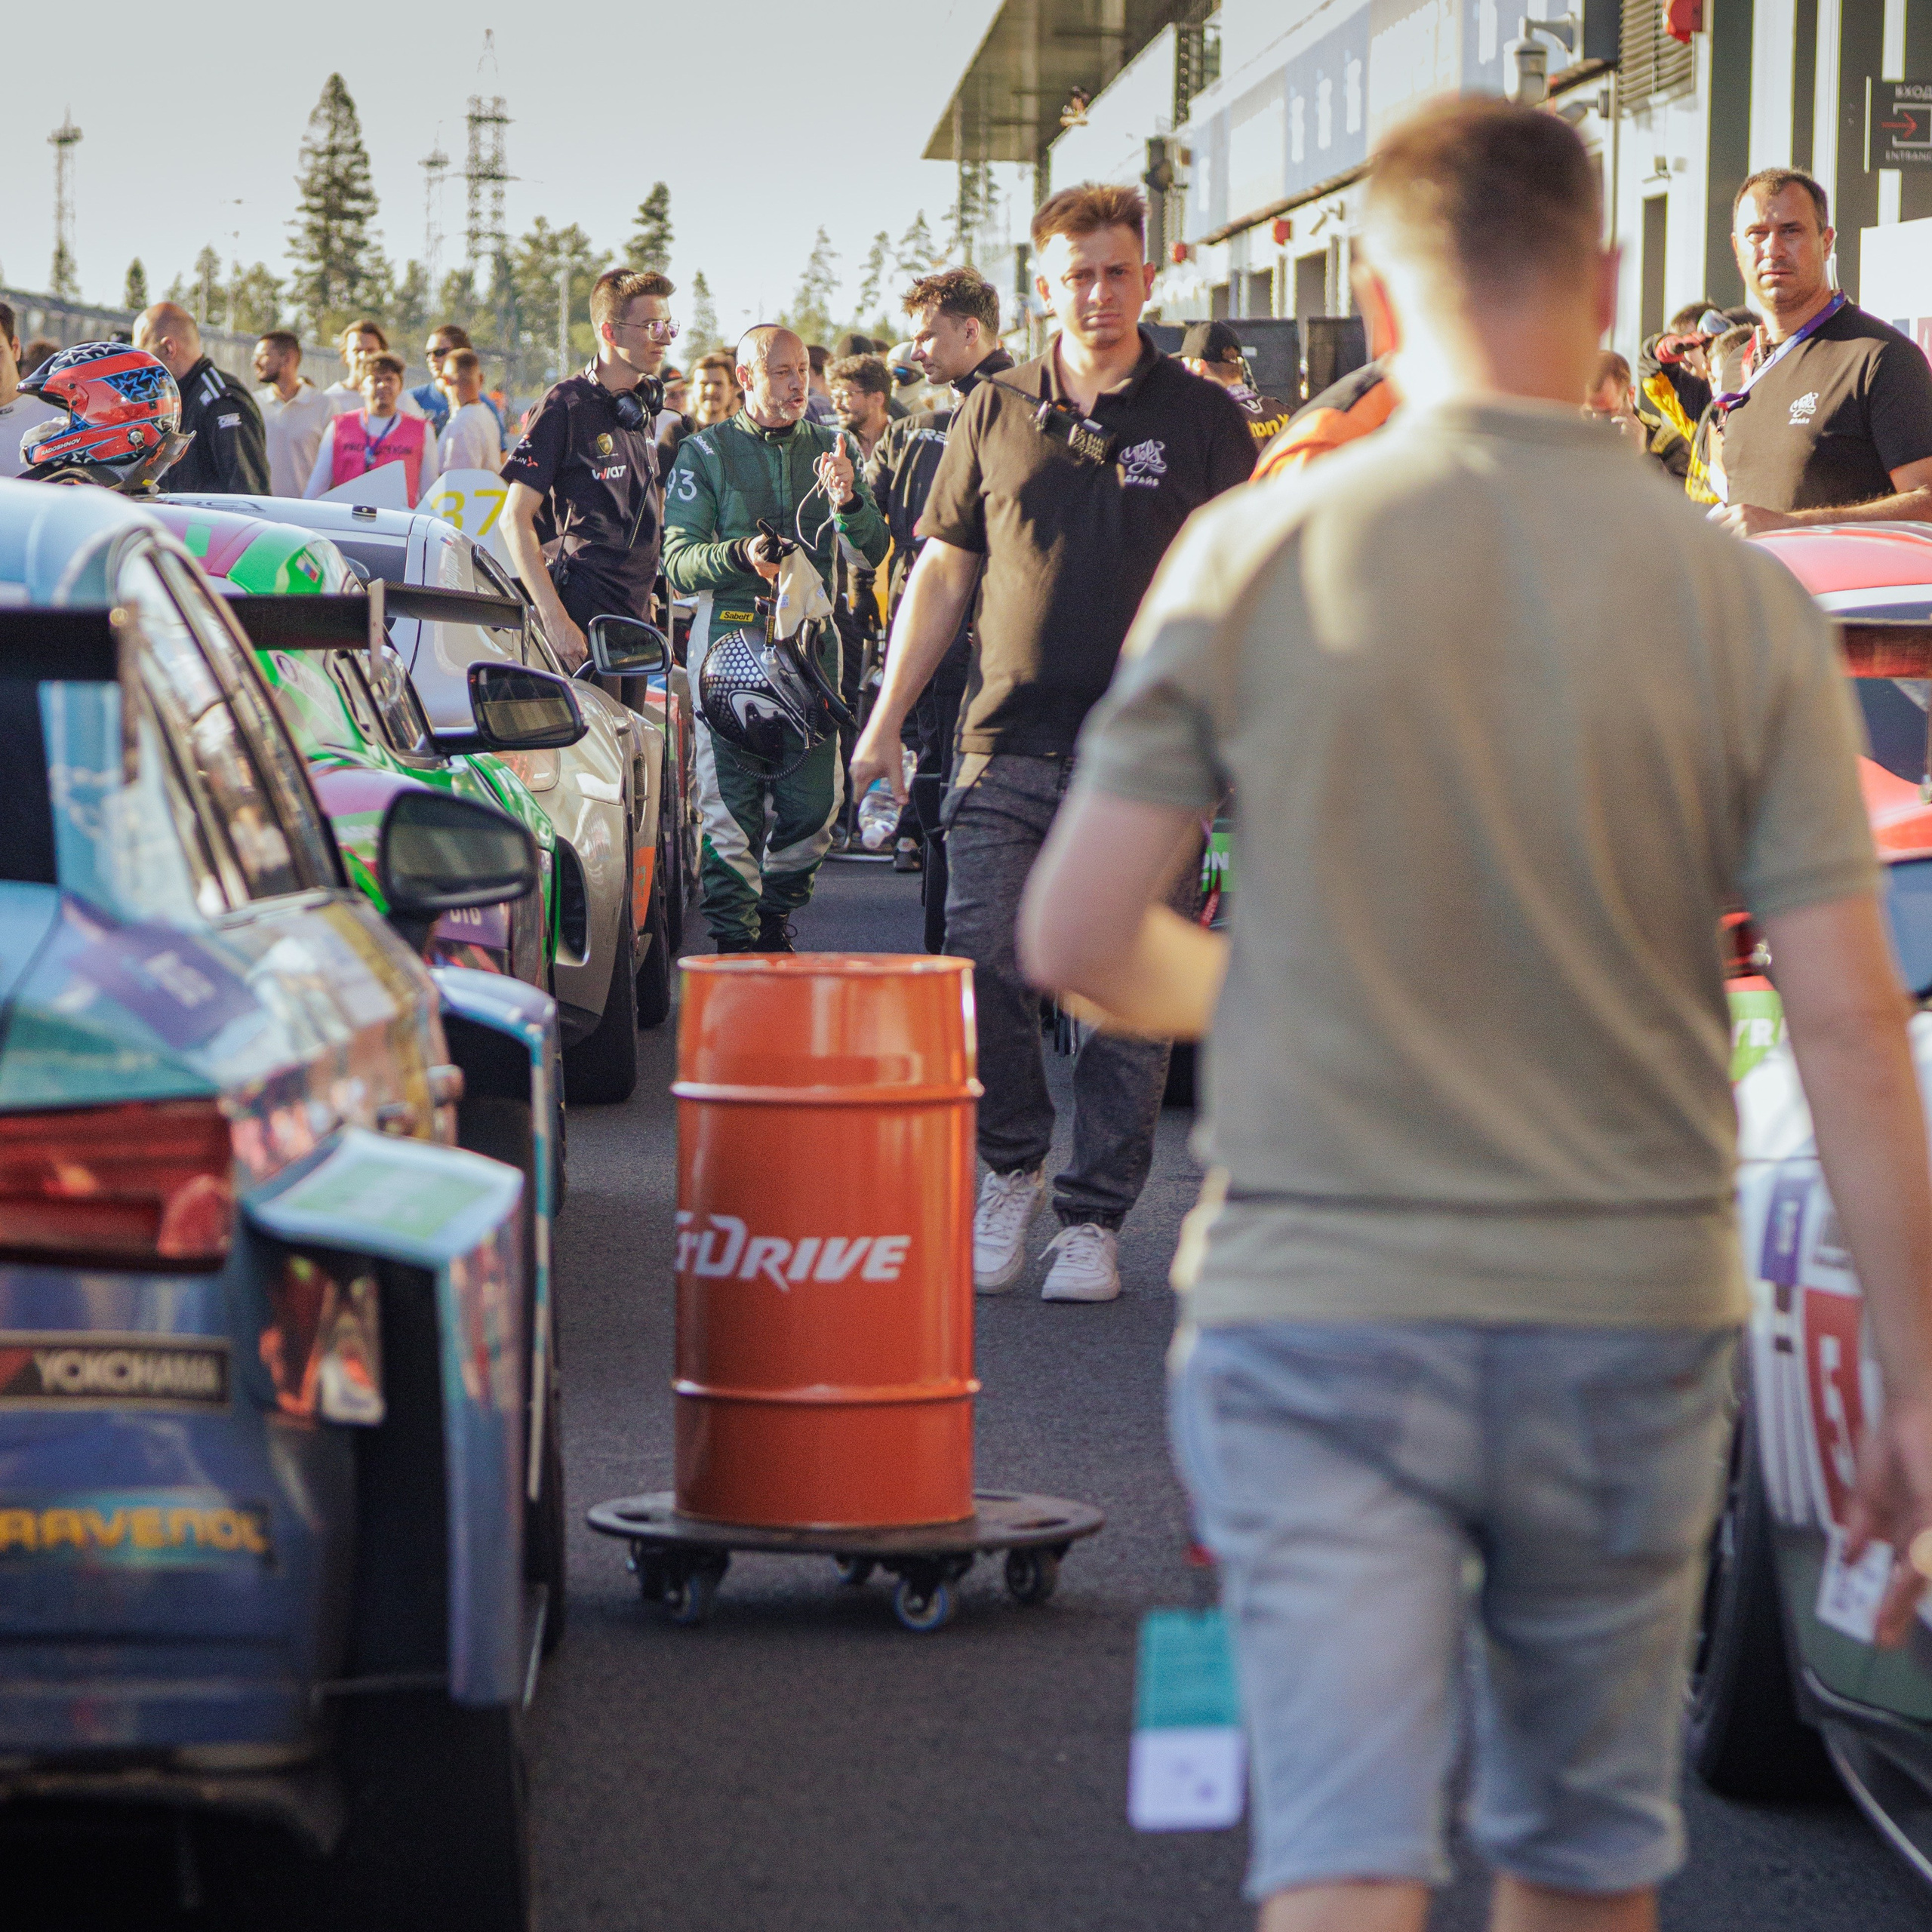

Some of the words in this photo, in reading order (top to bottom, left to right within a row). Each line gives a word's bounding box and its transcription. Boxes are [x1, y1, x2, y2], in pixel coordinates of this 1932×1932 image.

[41, 437, 82, 456] RADOSHNOV
[666, 467, 697, 501] 93
[430, 489, 508, 536] 37
[723, 611, 751, 621] Sabelt
